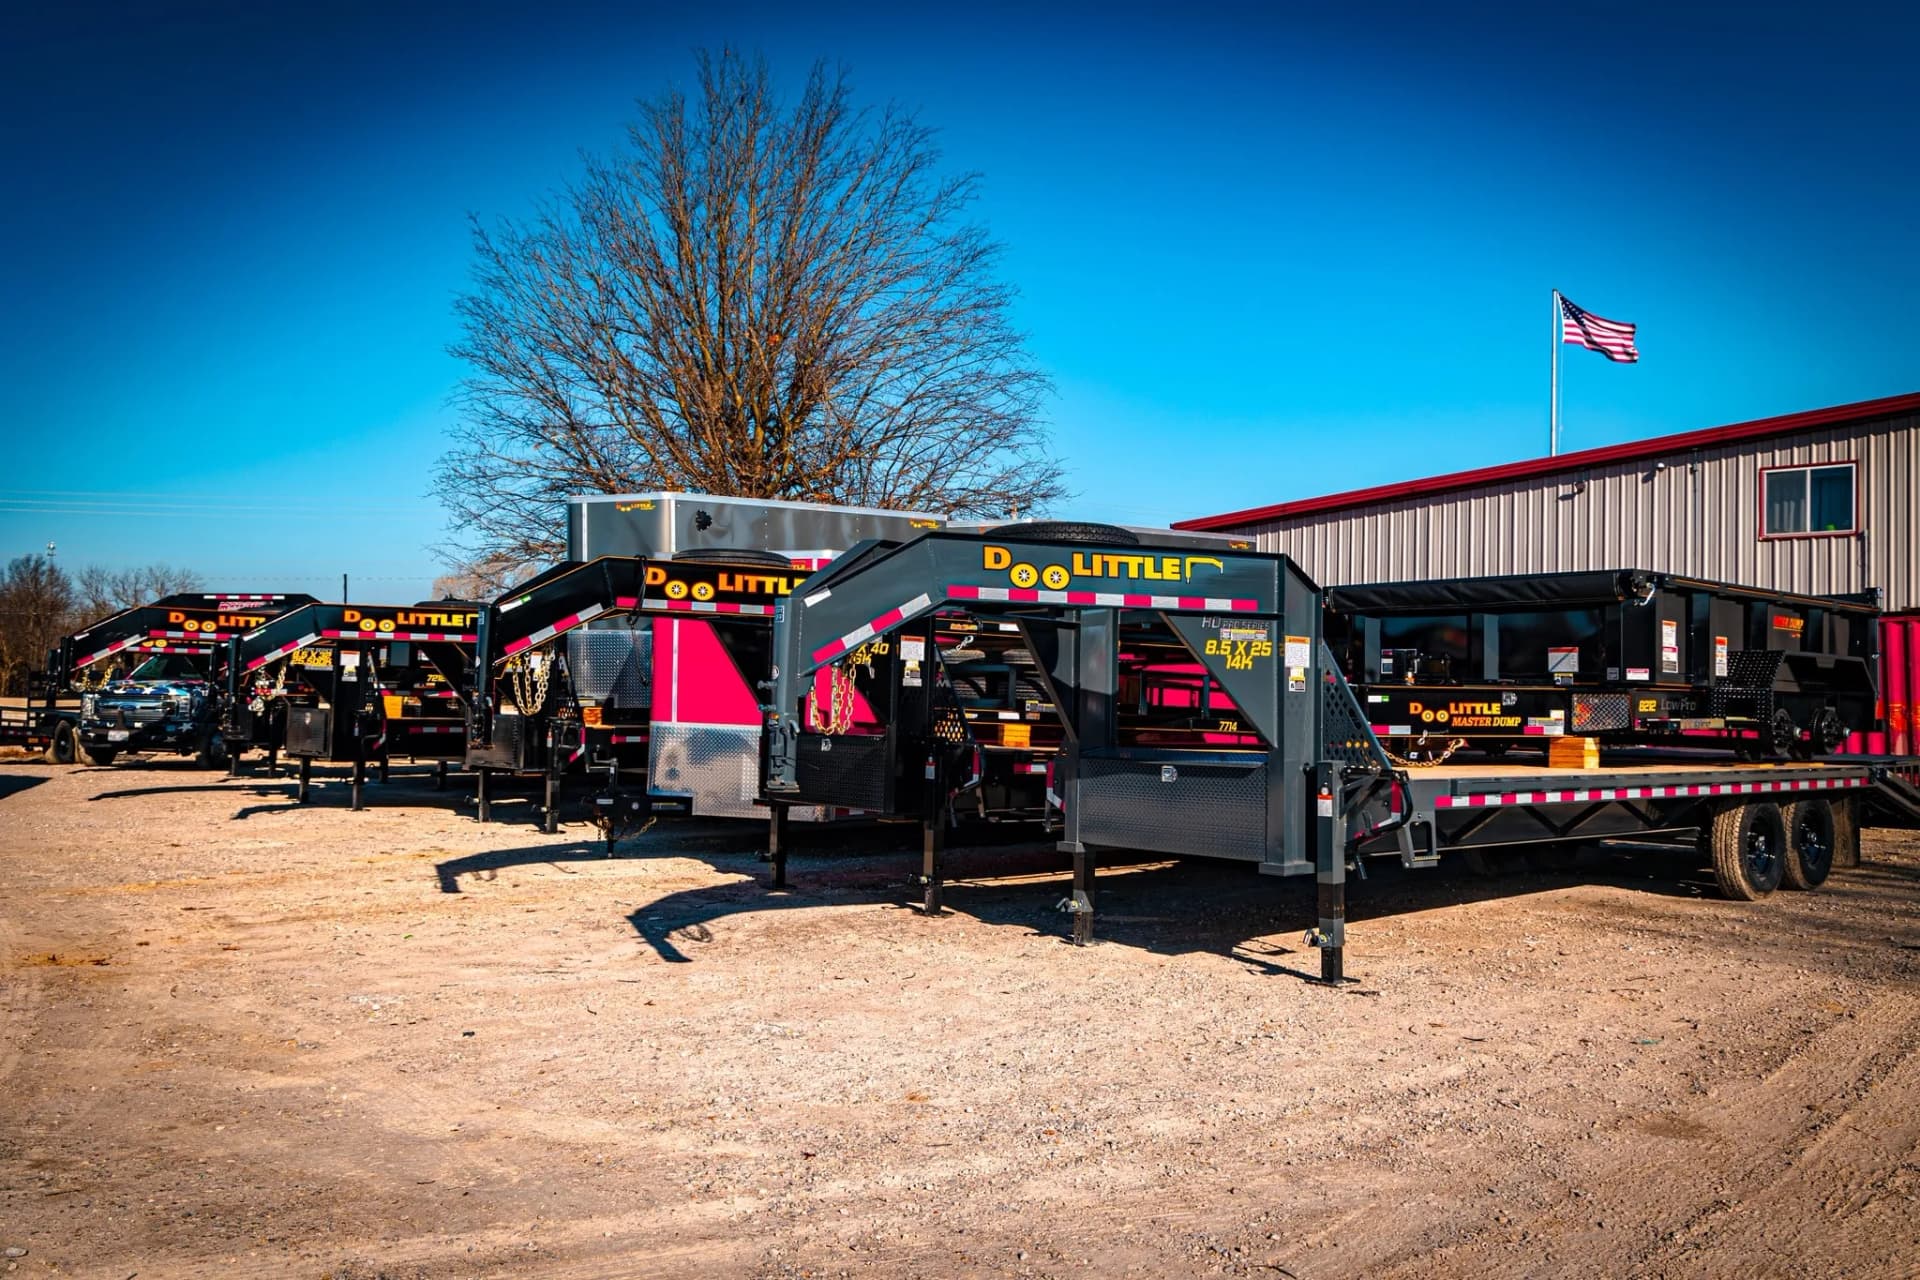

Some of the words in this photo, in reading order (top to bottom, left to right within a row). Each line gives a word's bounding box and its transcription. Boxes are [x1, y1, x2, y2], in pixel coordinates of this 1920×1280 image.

[983, 545, 1182, 590] DOOLITTLE
[343, 610, 464, 632] DOOLITTLE
[871, 643, 889, 655] 40
[1205, 640, 1231, 655] 8.5
[1234, 641, 1248, 656] X
[1251, 641, 1272, 656] 25
[1226, 655, 1253, 670] 14K
[1409, 702, 1501, 722] DOOLITTLE
[1219, 721, 1238, 732] 7714
[1451, 716, 1491, 727] MASTER
[1492, 717, 1521, 727] DUMP
